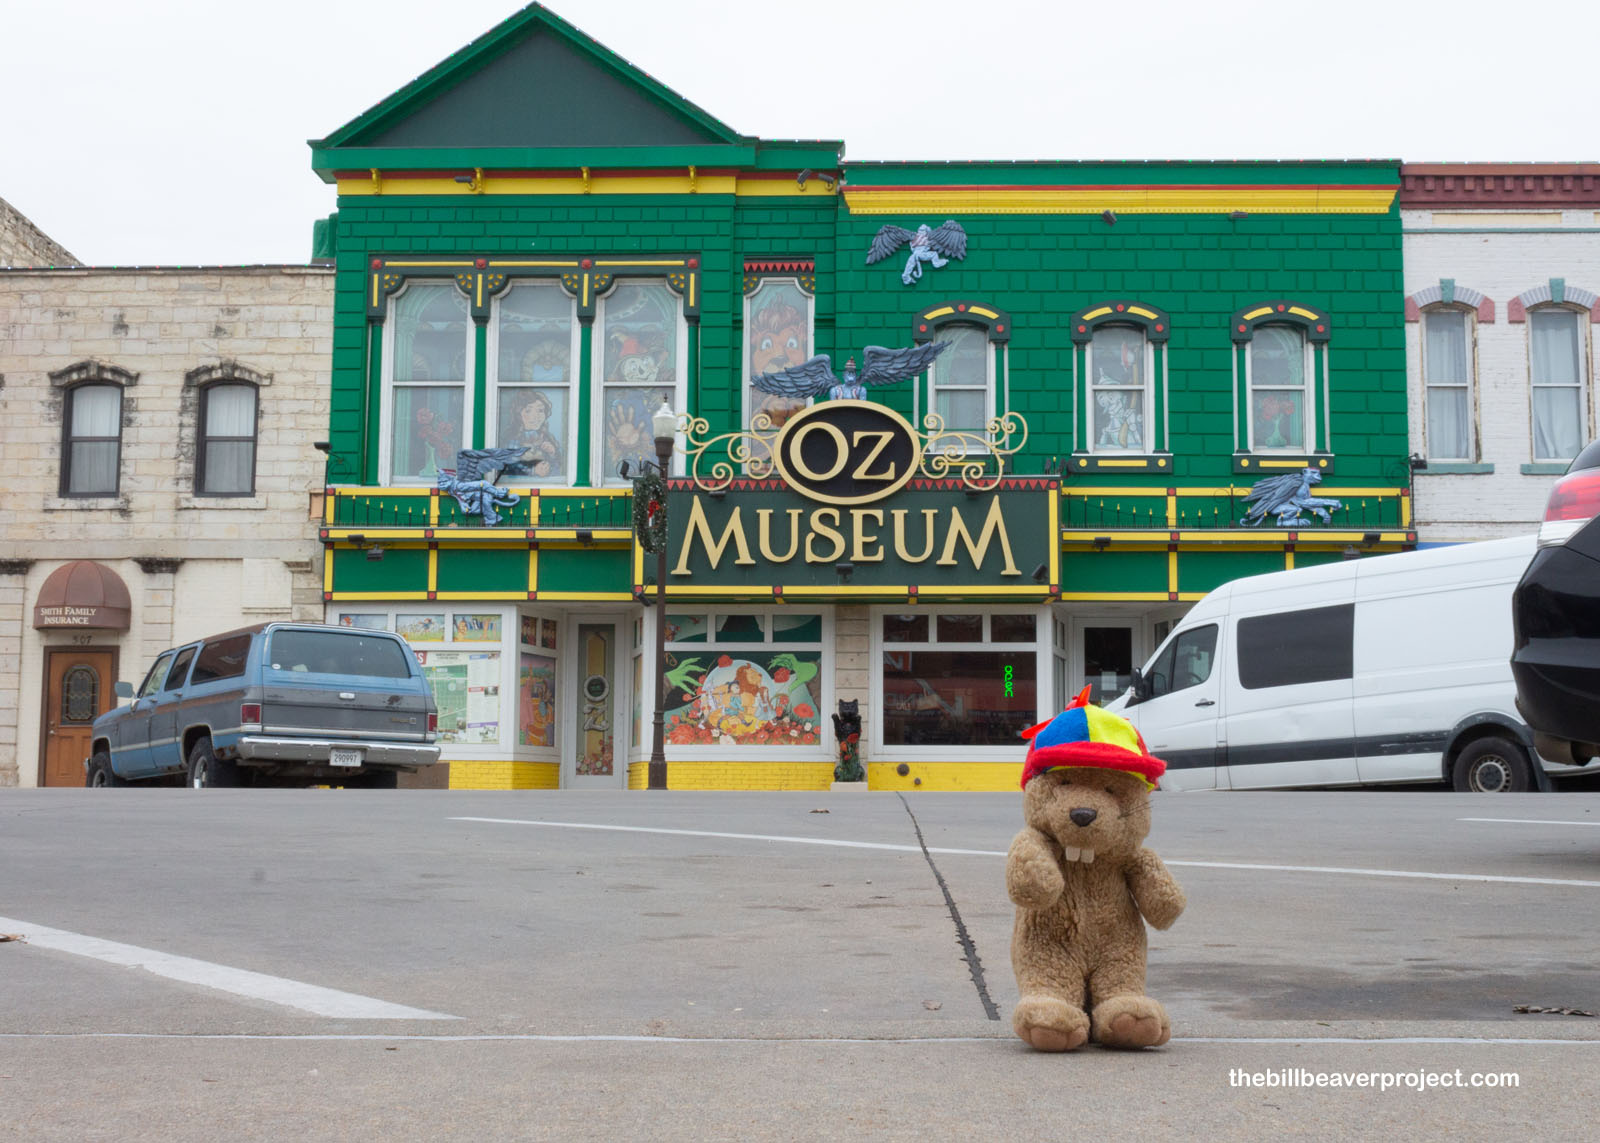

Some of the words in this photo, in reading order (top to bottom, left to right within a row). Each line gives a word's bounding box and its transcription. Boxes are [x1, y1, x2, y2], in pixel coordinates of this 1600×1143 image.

[670, 494, 1022, 577] MUSEUM
[40, 607, 62, 616] SMITH
[64, 606, 96, 616] FAMILY
[44, 616, 89, 625] INSURANCE
